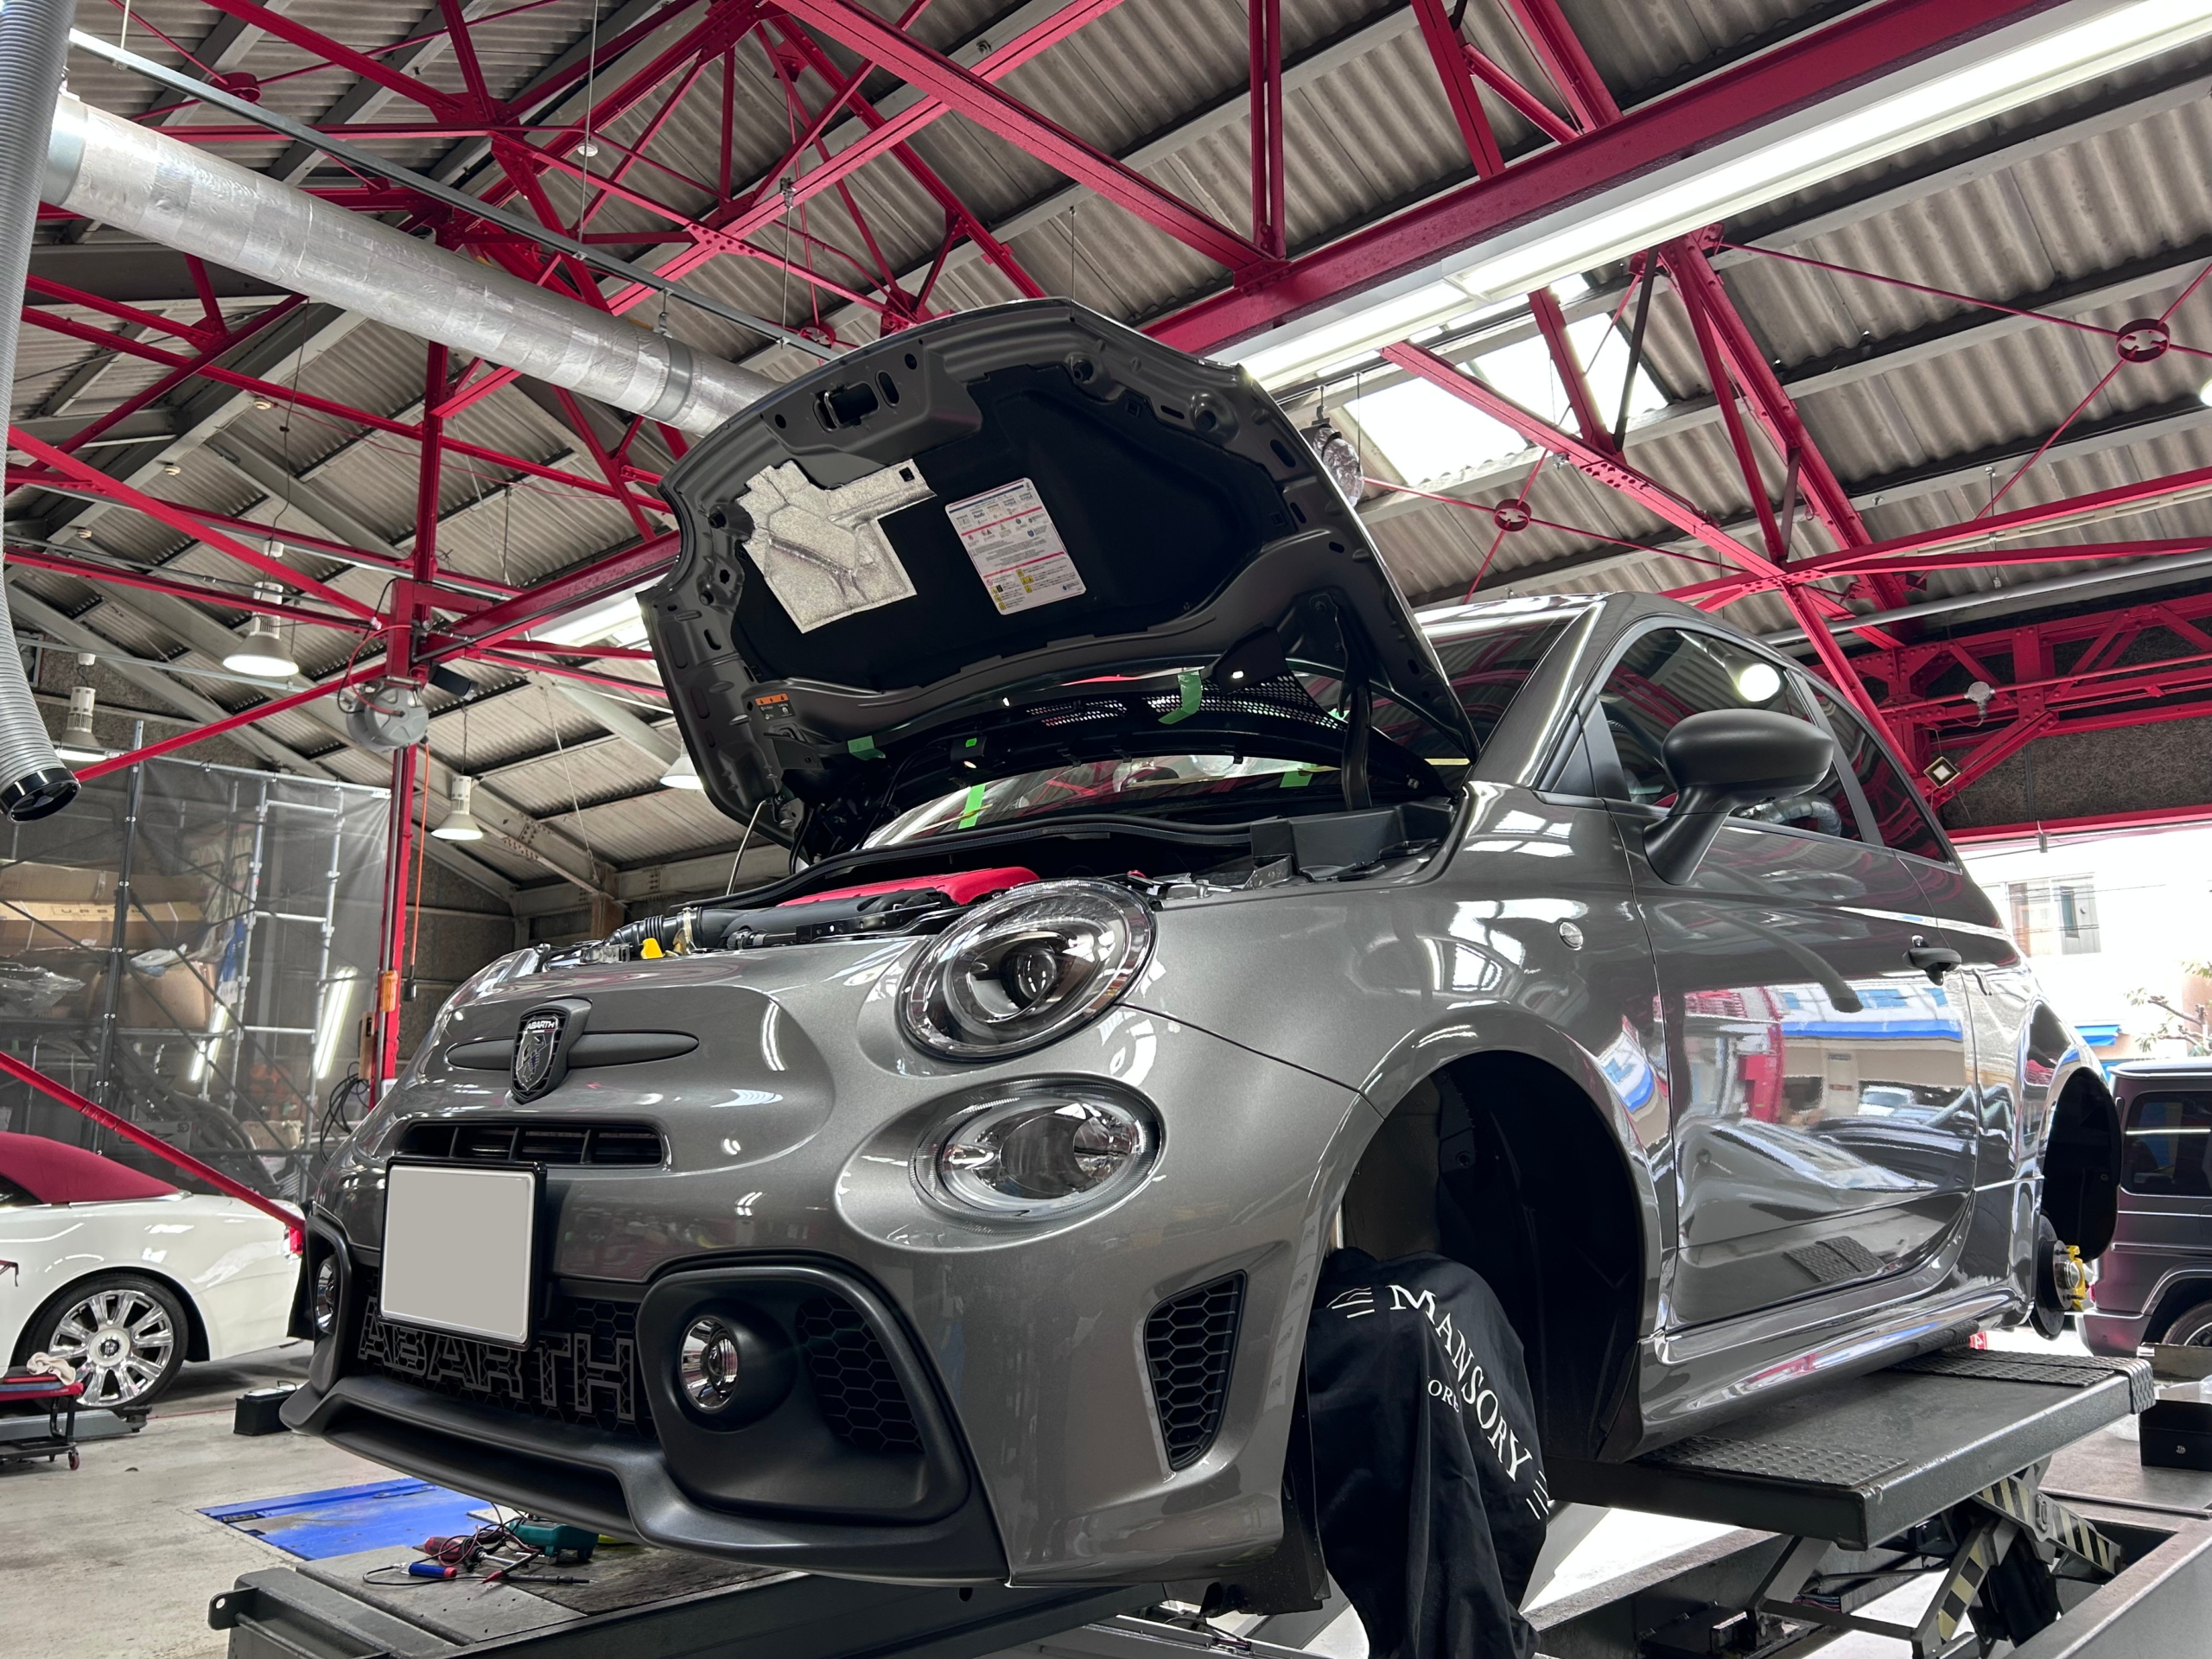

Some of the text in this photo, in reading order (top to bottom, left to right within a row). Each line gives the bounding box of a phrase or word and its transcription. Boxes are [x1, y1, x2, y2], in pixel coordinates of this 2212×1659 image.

[526, 1020, 555, 1031] ABARTH
[1386, 1284, 1533, 1483] MANSORY
[1427, 1376, 1460, 1414] ORE
